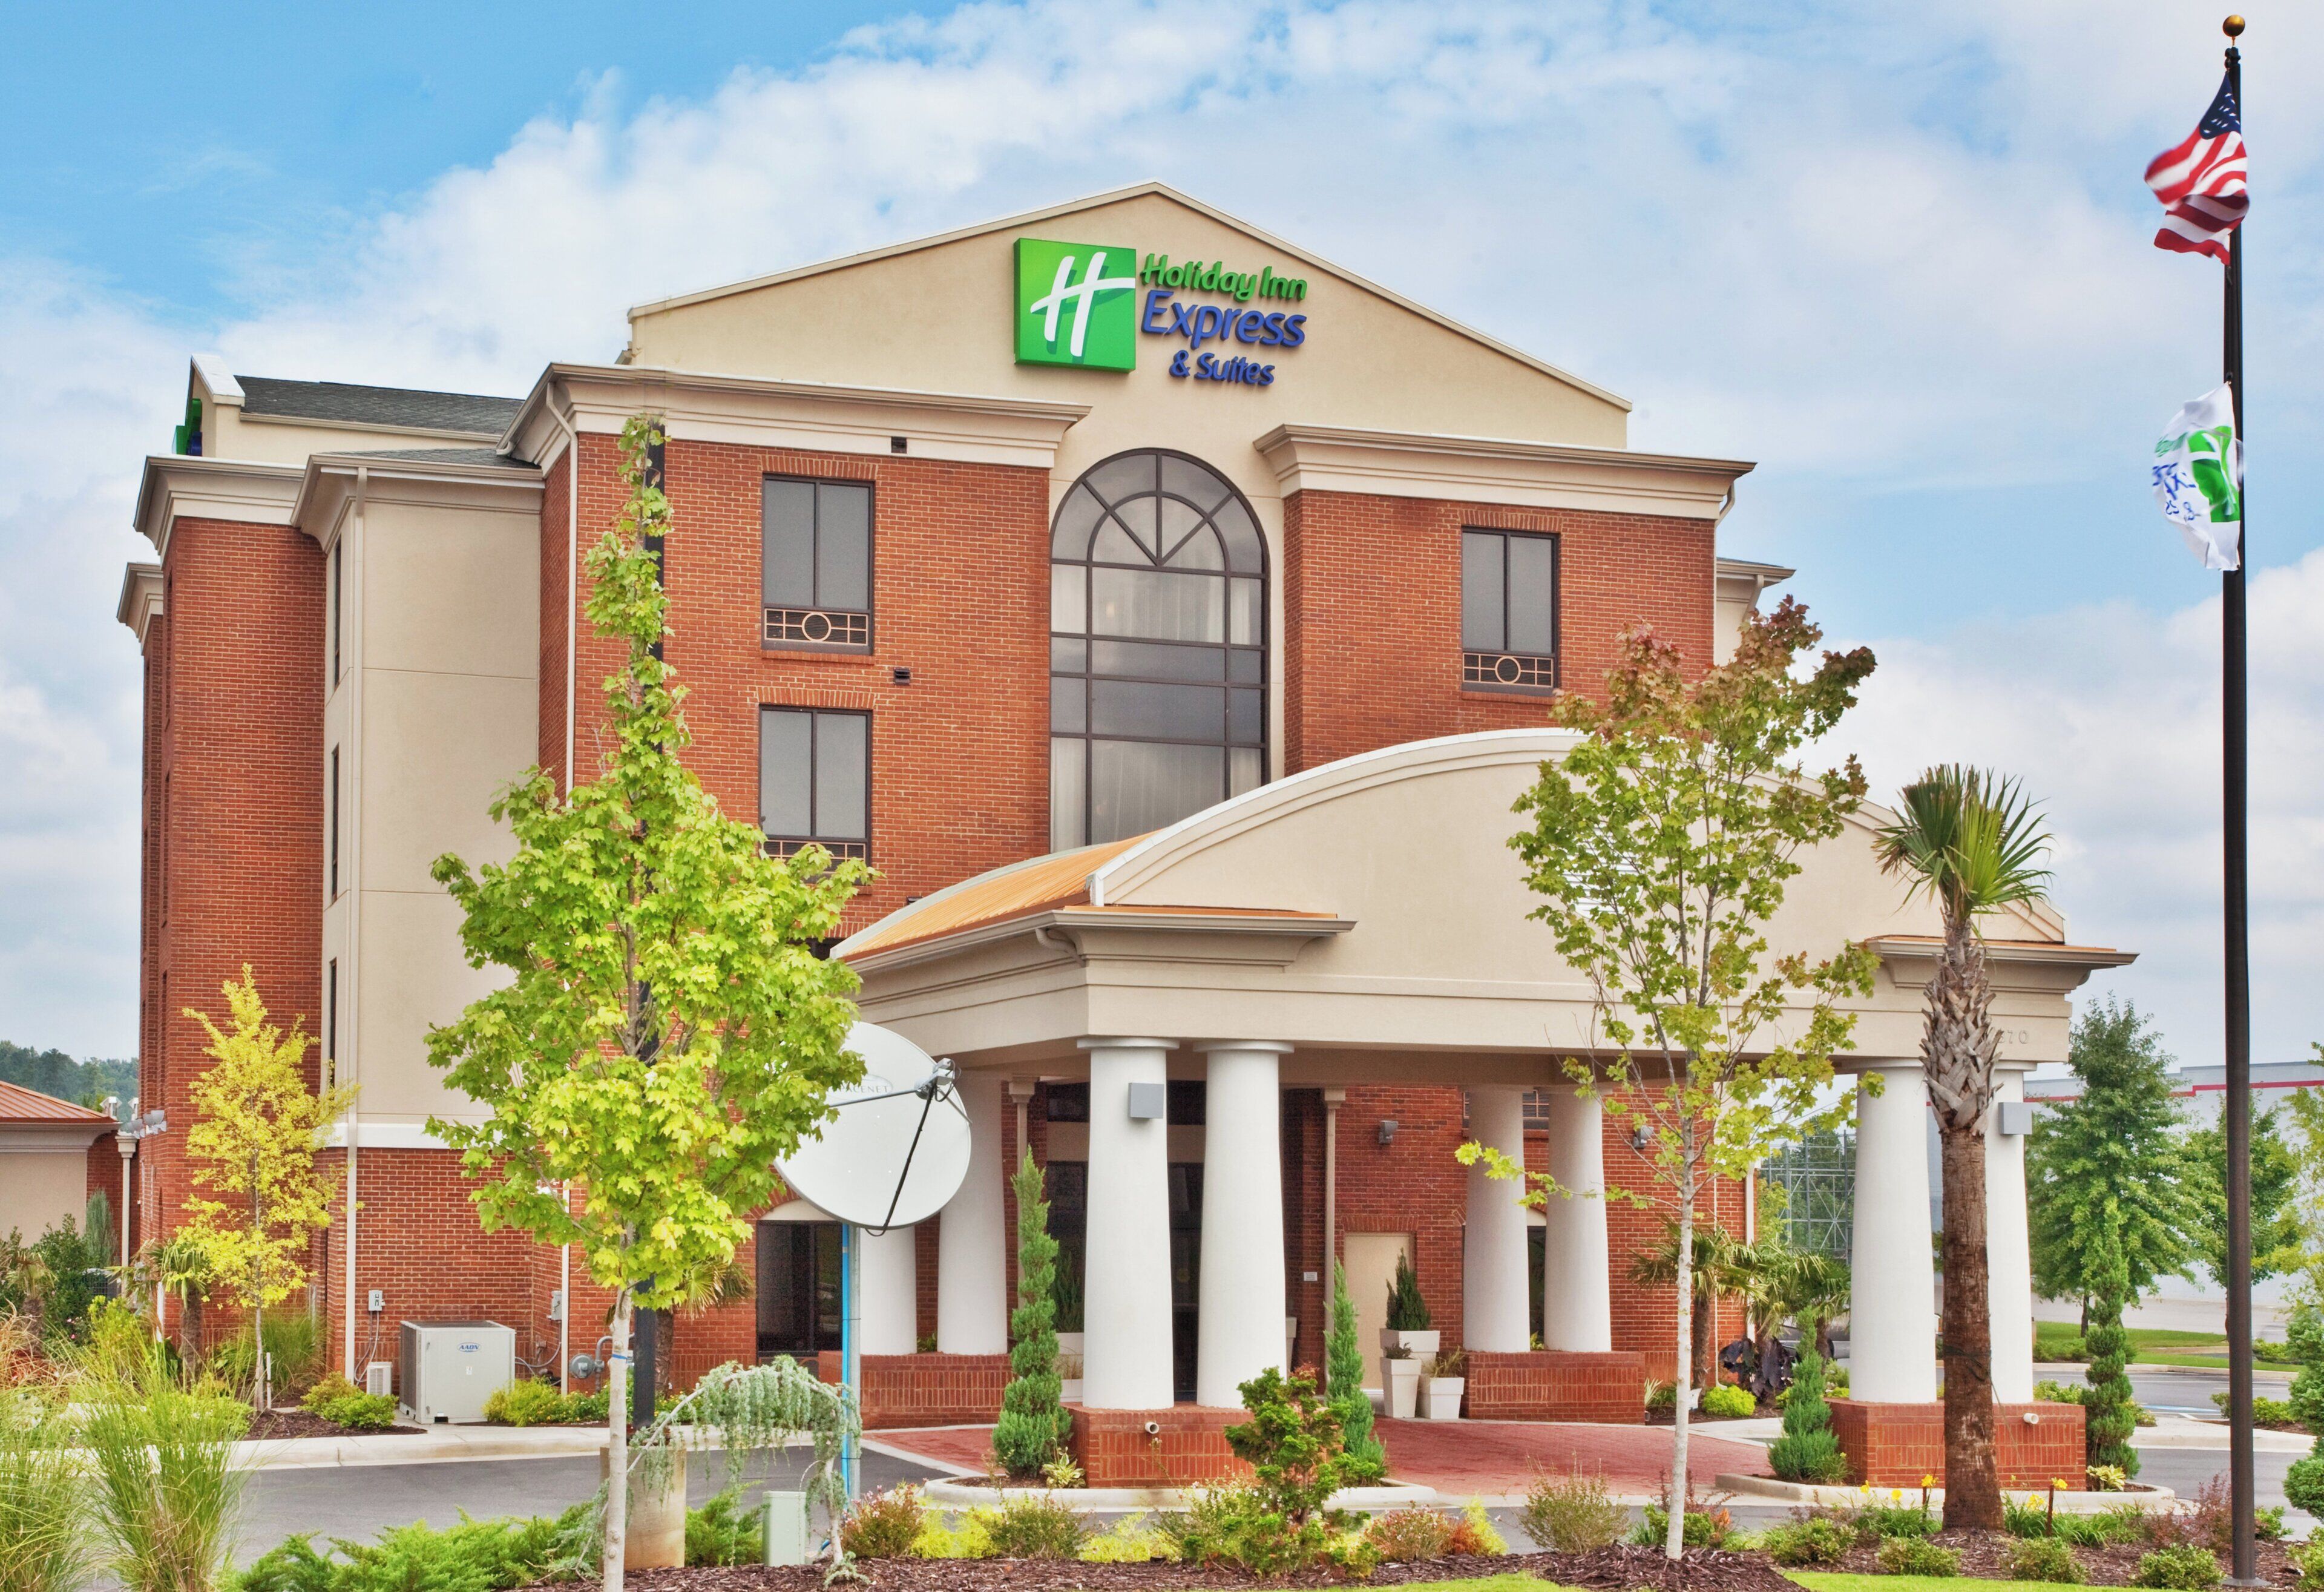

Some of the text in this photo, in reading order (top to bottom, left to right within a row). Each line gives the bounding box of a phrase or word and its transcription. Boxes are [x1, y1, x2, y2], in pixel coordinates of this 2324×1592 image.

[1140, 254, 1307, 302] Holiday Inn
[1141, 290, 1307, 350] Express
[1169, 350, 1275, 386] & Suites
